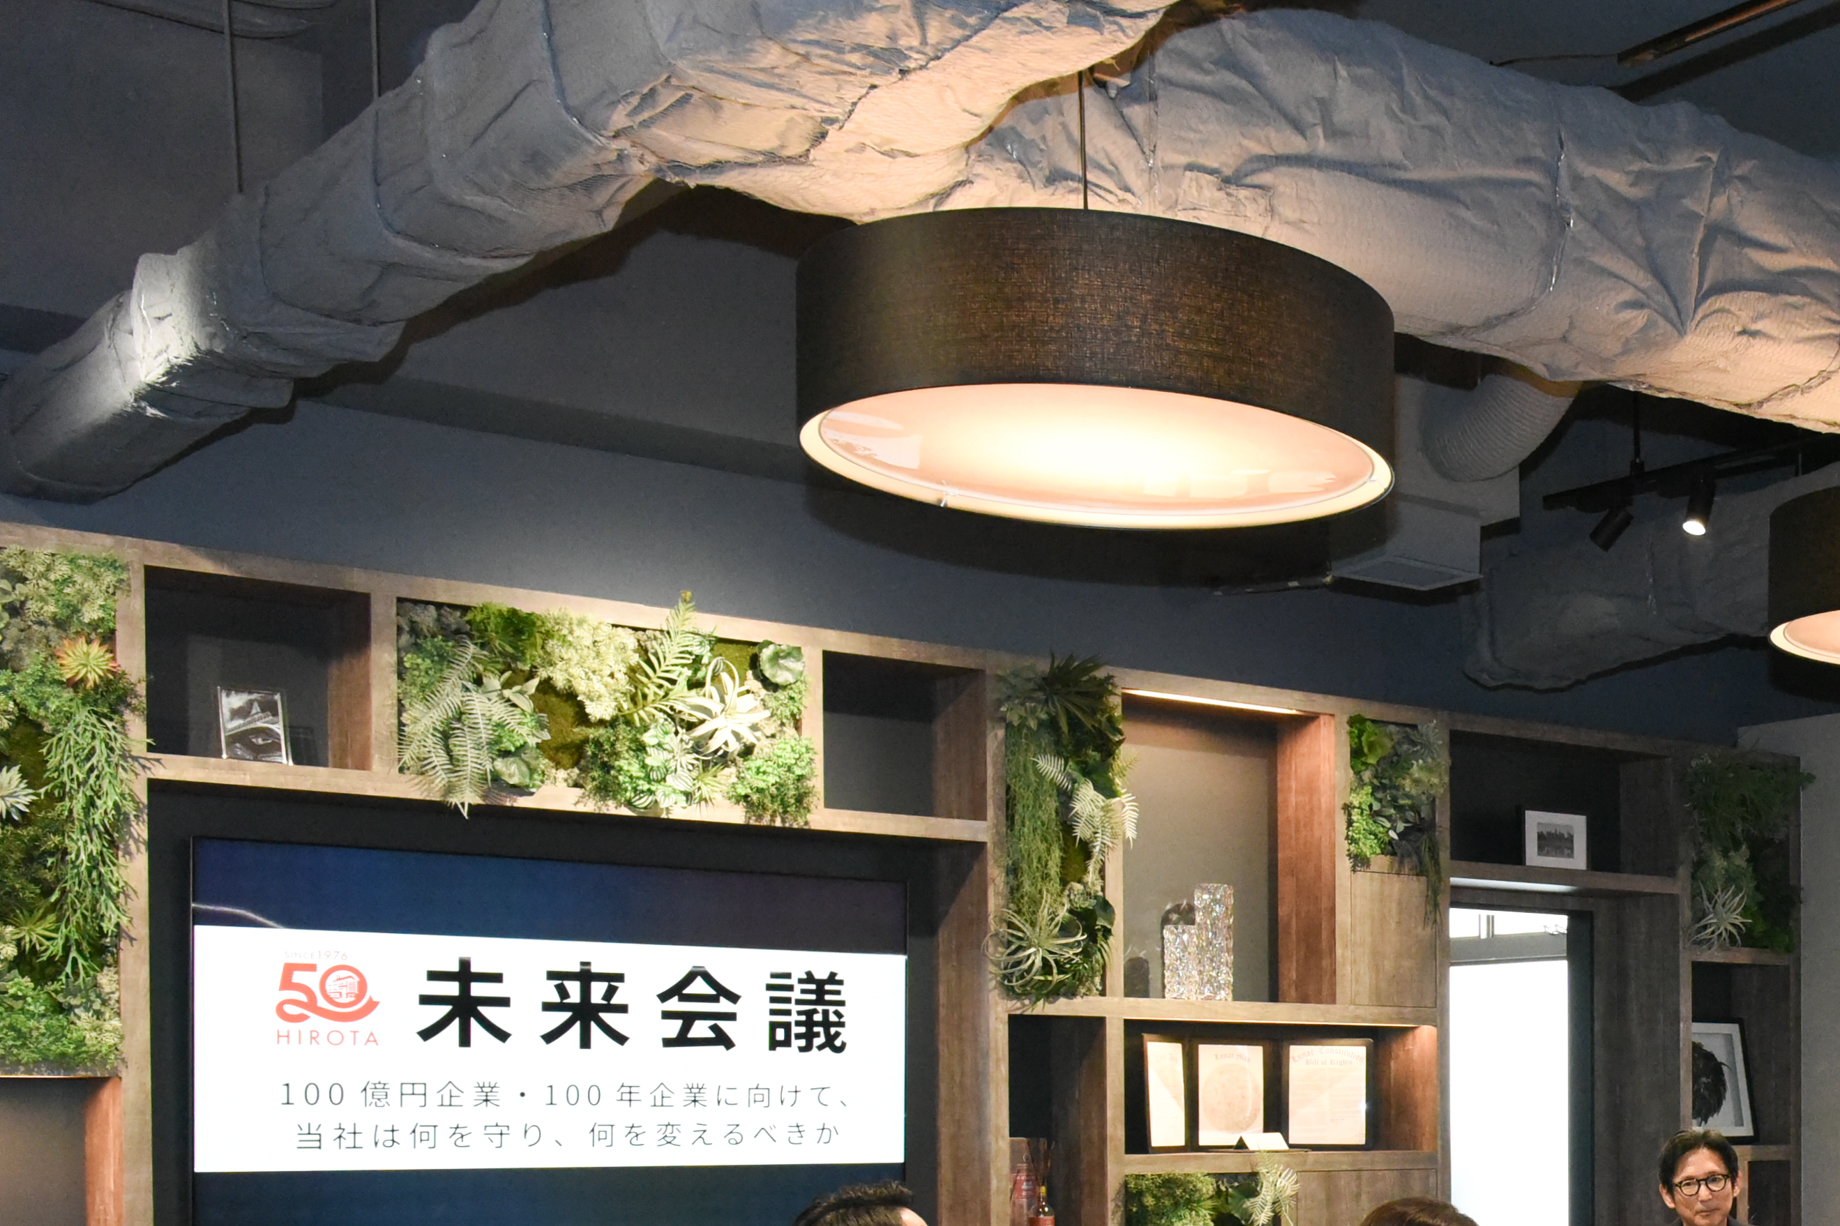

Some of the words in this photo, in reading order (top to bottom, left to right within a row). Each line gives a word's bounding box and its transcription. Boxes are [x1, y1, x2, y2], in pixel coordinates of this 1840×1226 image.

[416, 956, 847, 1054] 未来会議
[277, 1029, 379, 1046] HIROTA
[295, 1121, 840, 1151] 当社は何を守り、何を変えるべきか
